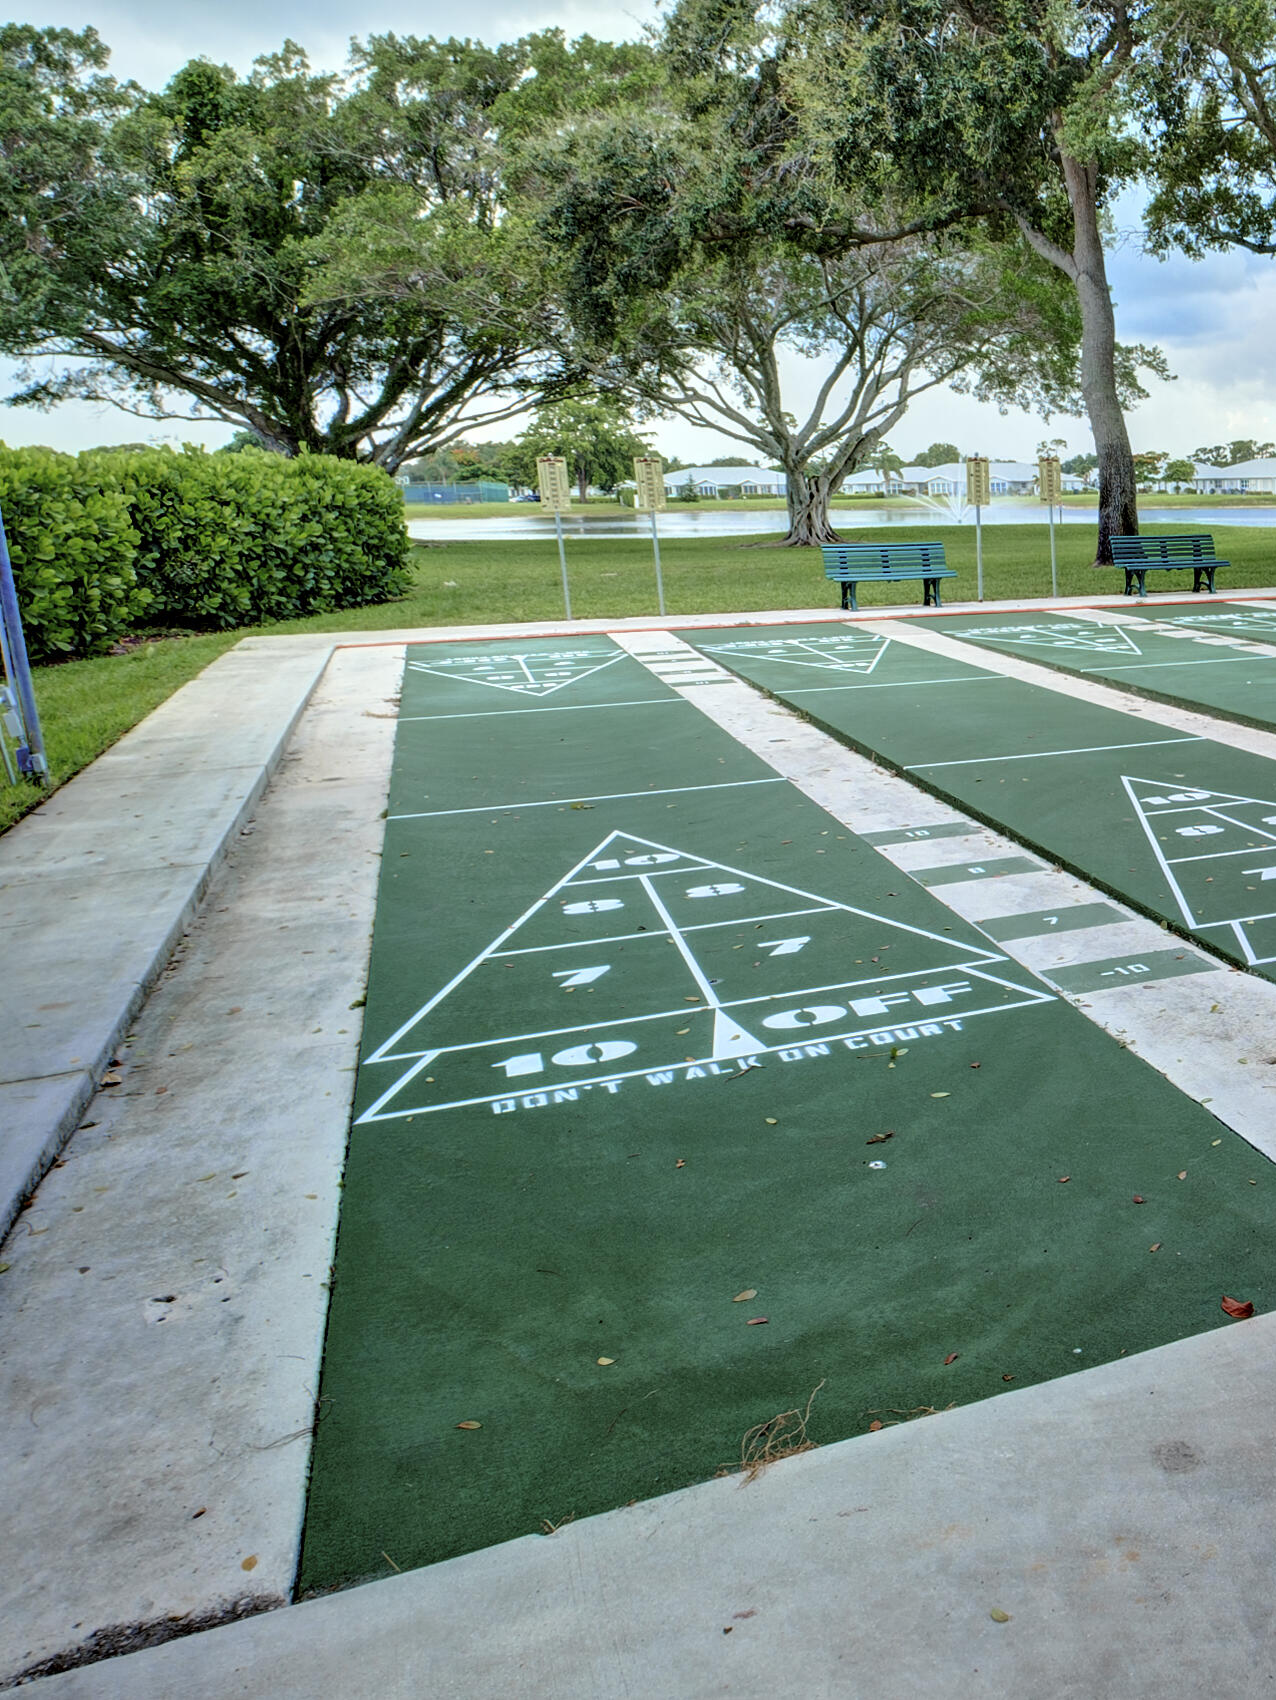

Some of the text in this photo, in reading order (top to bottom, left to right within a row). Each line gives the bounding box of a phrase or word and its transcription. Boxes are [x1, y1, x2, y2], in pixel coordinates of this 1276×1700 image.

[1139, 792, 1212, 805] 10
[904, 829, 931, 838] 10
[1175, 824, 1226, 837] 8
[586, 853, 681, 871] 10
[685, 882, 746, 898] 8
[561, 898, 625, 915] 8
[1042, 916, 1059, 925] 7
[756, 935, 812, 956] 7
[551, 964, 611, 988] 7
[1100, 962, 1152, 976] -10
[491, 980, 973, 1078] 10 OFF
[491, 1018, 964, 1116] DON'T WALK ON COURT
